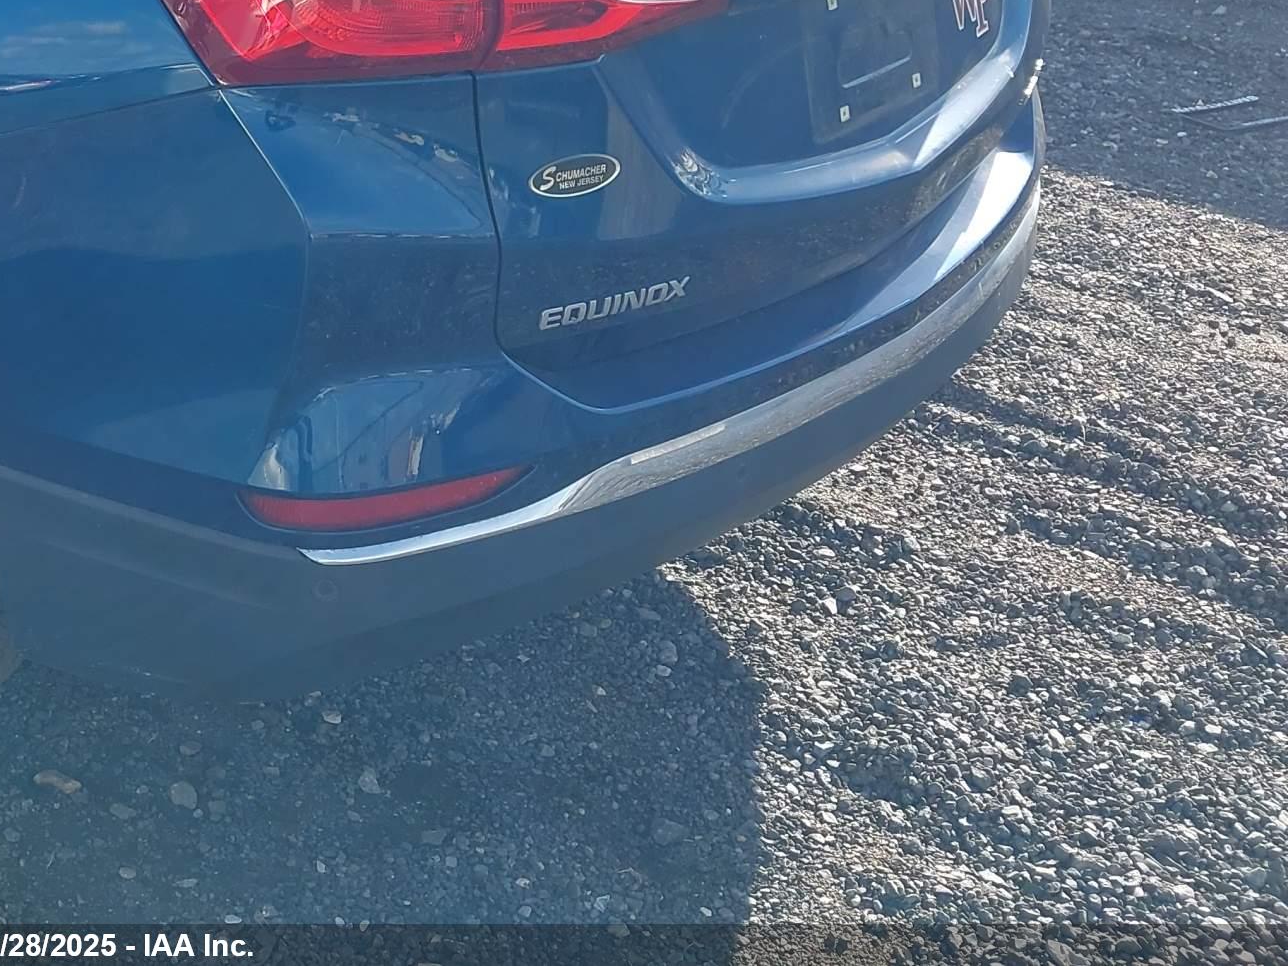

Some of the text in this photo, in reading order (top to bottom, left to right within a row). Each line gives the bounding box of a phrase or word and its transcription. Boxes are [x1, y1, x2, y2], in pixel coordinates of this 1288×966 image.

[539, 163, 607, 191] SCHUMACHER
[559, 174, 604, 190] NEW JERSEY
[538, 275, 691, 331] EQUINOX
